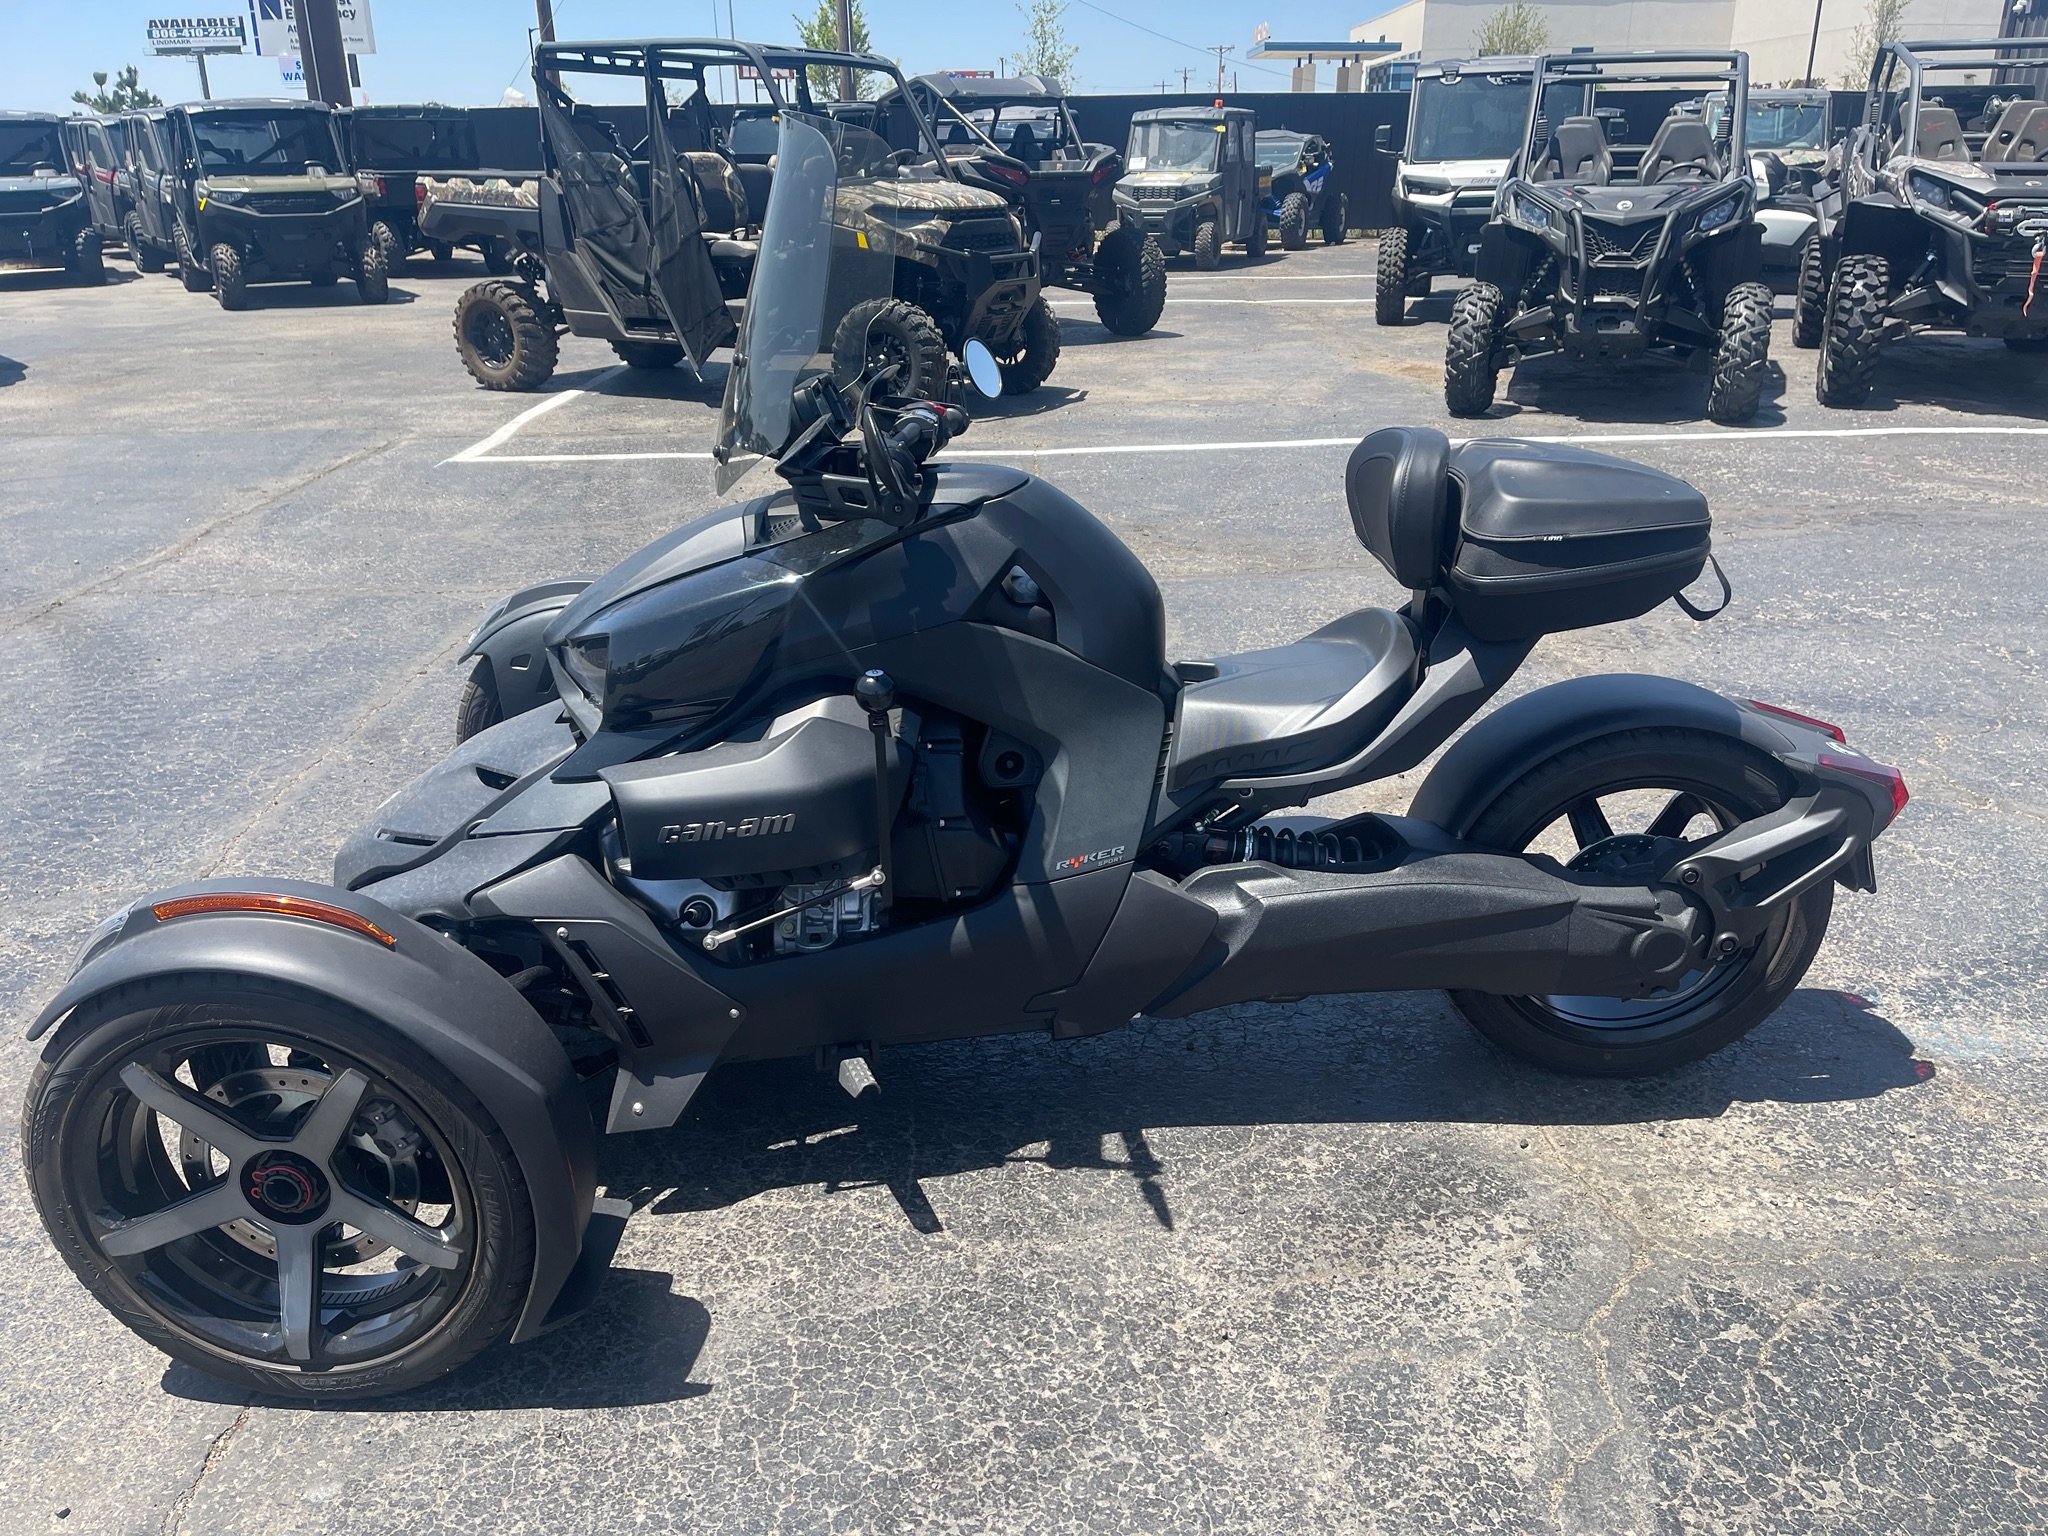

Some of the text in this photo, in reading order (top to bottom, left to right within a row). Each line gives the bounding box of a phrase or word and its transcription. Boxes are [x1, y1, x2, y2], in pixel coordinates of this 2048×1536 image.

[148, 17, 237, 29] AVAILABLE
[152, 27, 236, 38] 806-410-2211
[152, 38, 192, 46] LINDMARK
[657, 813, 796, 844] can-am
[1055, 845, 1125, 871] RYKER
[1097, 856, 1123, 867] SPORT
